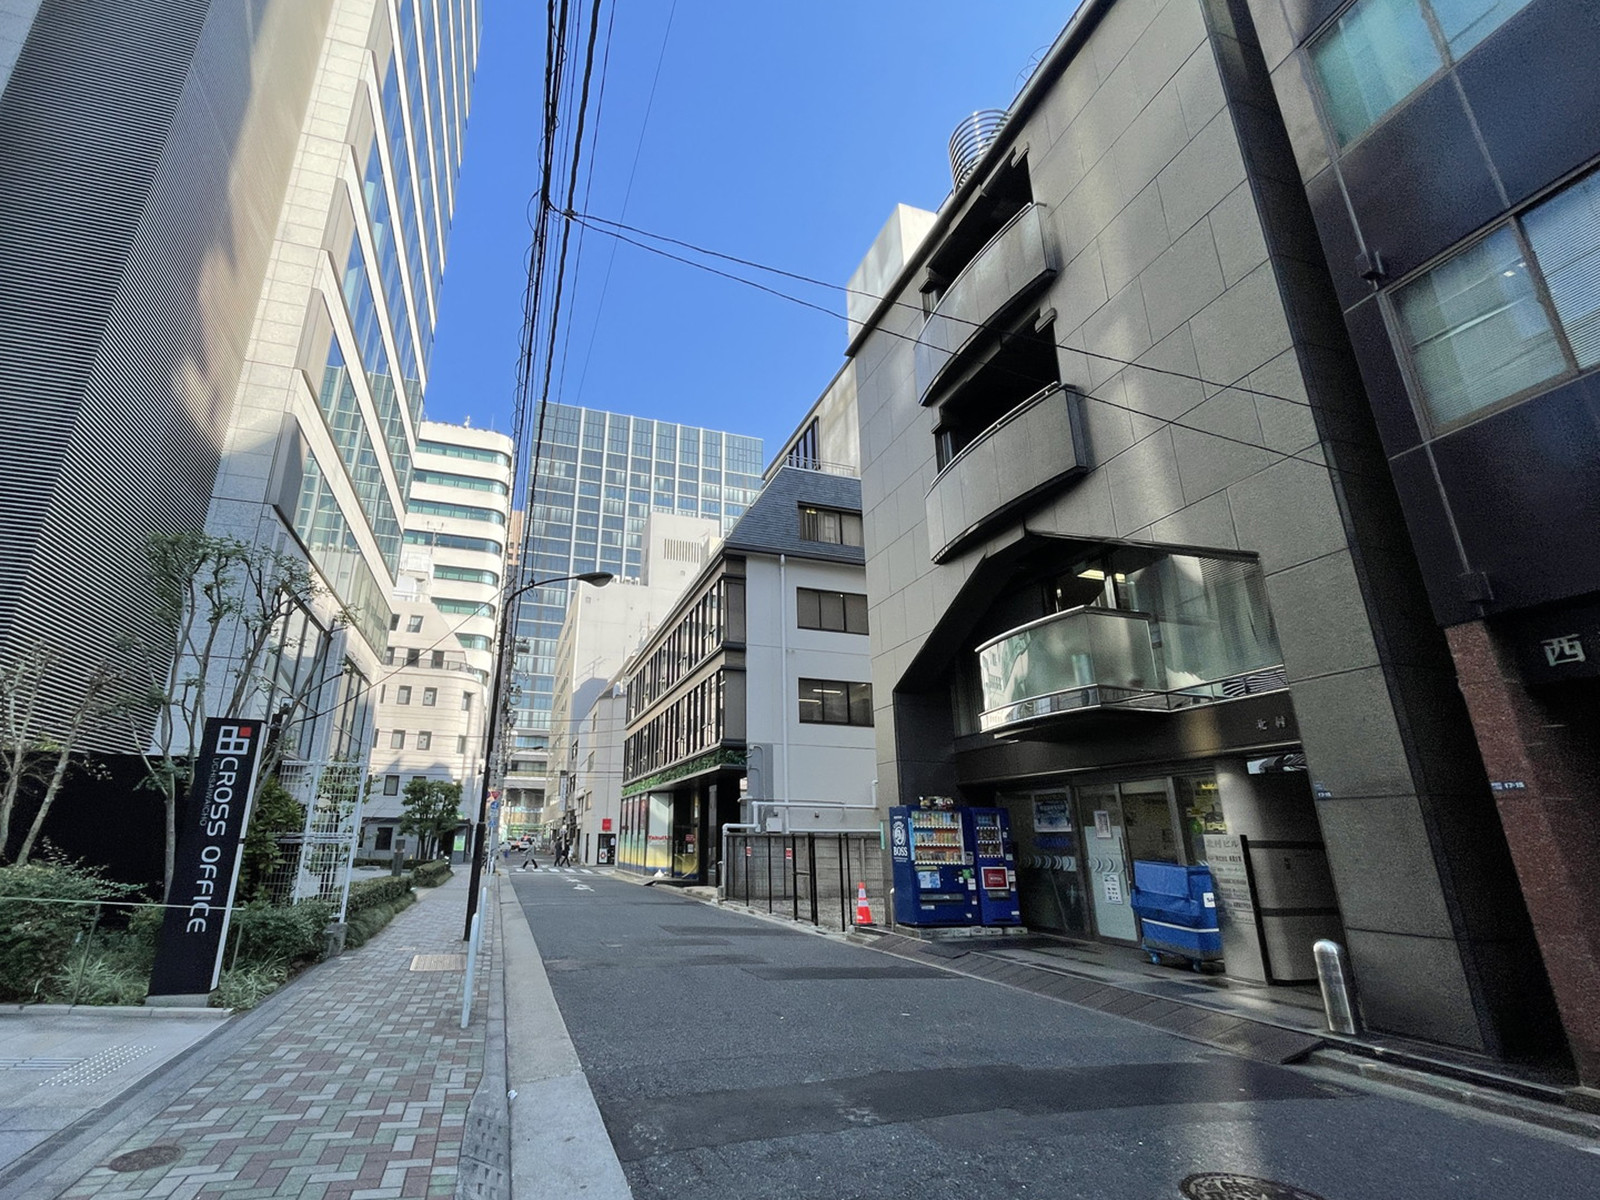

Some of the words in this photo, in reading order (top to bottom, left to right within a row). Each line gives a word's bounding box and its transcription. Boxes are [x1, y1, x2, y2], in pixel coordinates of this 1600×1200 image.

[1540, 633, 1586, 667] 西
[206, 756, 239, 837] CROSS
[893, 846, 908, 857] BOSS
[186, 845, 221, 934] OFFICE
